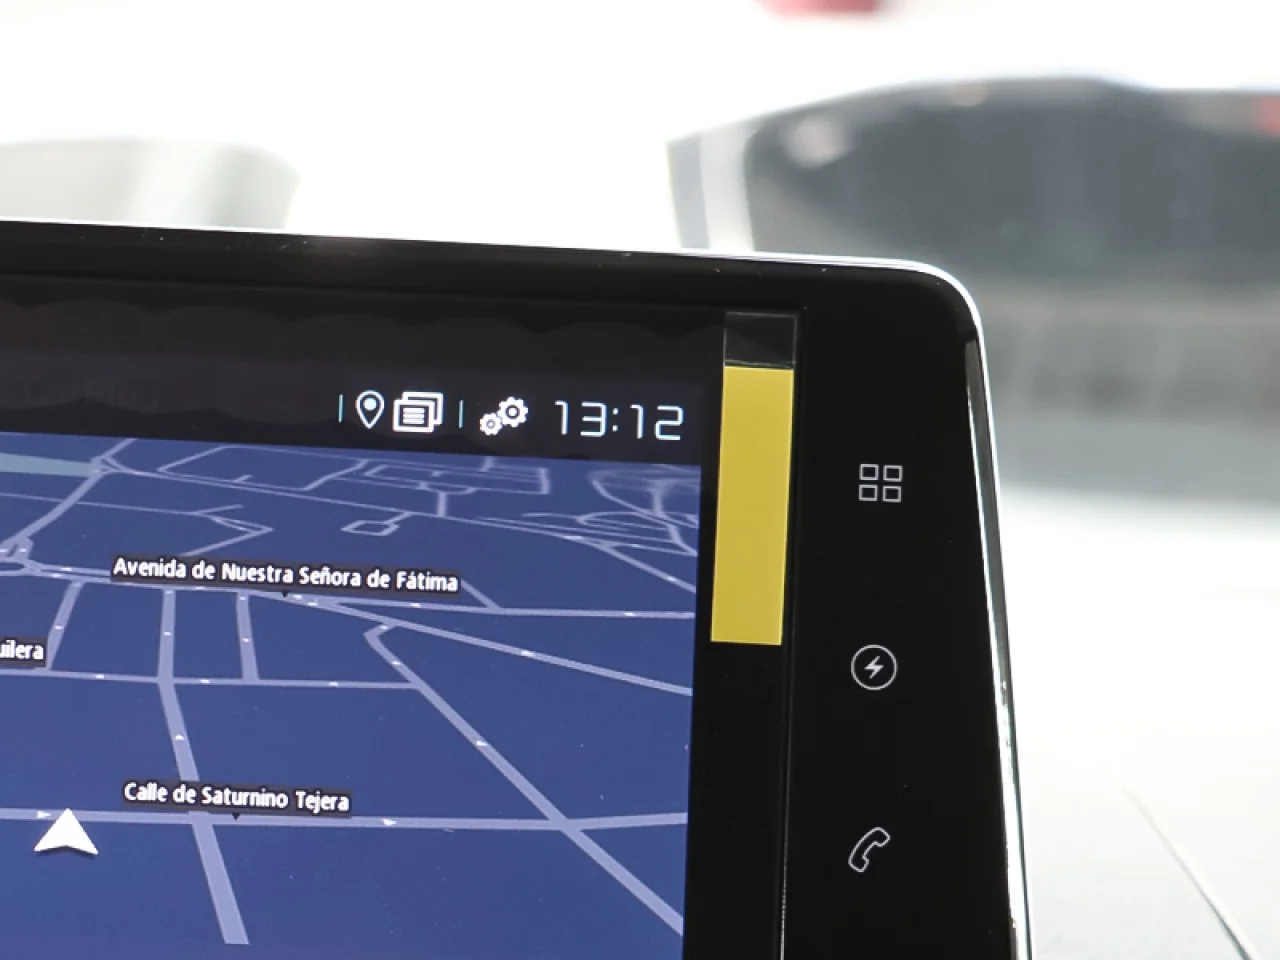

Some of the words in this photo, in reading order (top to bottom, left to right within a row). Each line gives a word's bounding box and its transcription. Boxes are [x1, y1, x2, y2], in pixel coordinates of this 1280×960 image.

[554, 400, 684, 441] 13:12
[113, 557, 187, 579] Avenida
[191, 559, 216, 580] de
[221, 562, 294, 584] Nuestra
[298, 566, 361, 587] Señora
[366, 569, 391, 588] de
[396, 570, 458, 592] Fátima
[124, 782, 169, 803] Calle
[172, 783, 197, 804] de
[201, 786, 289, 809] Saturnino
[295, 791, 350, 814] Tejera
